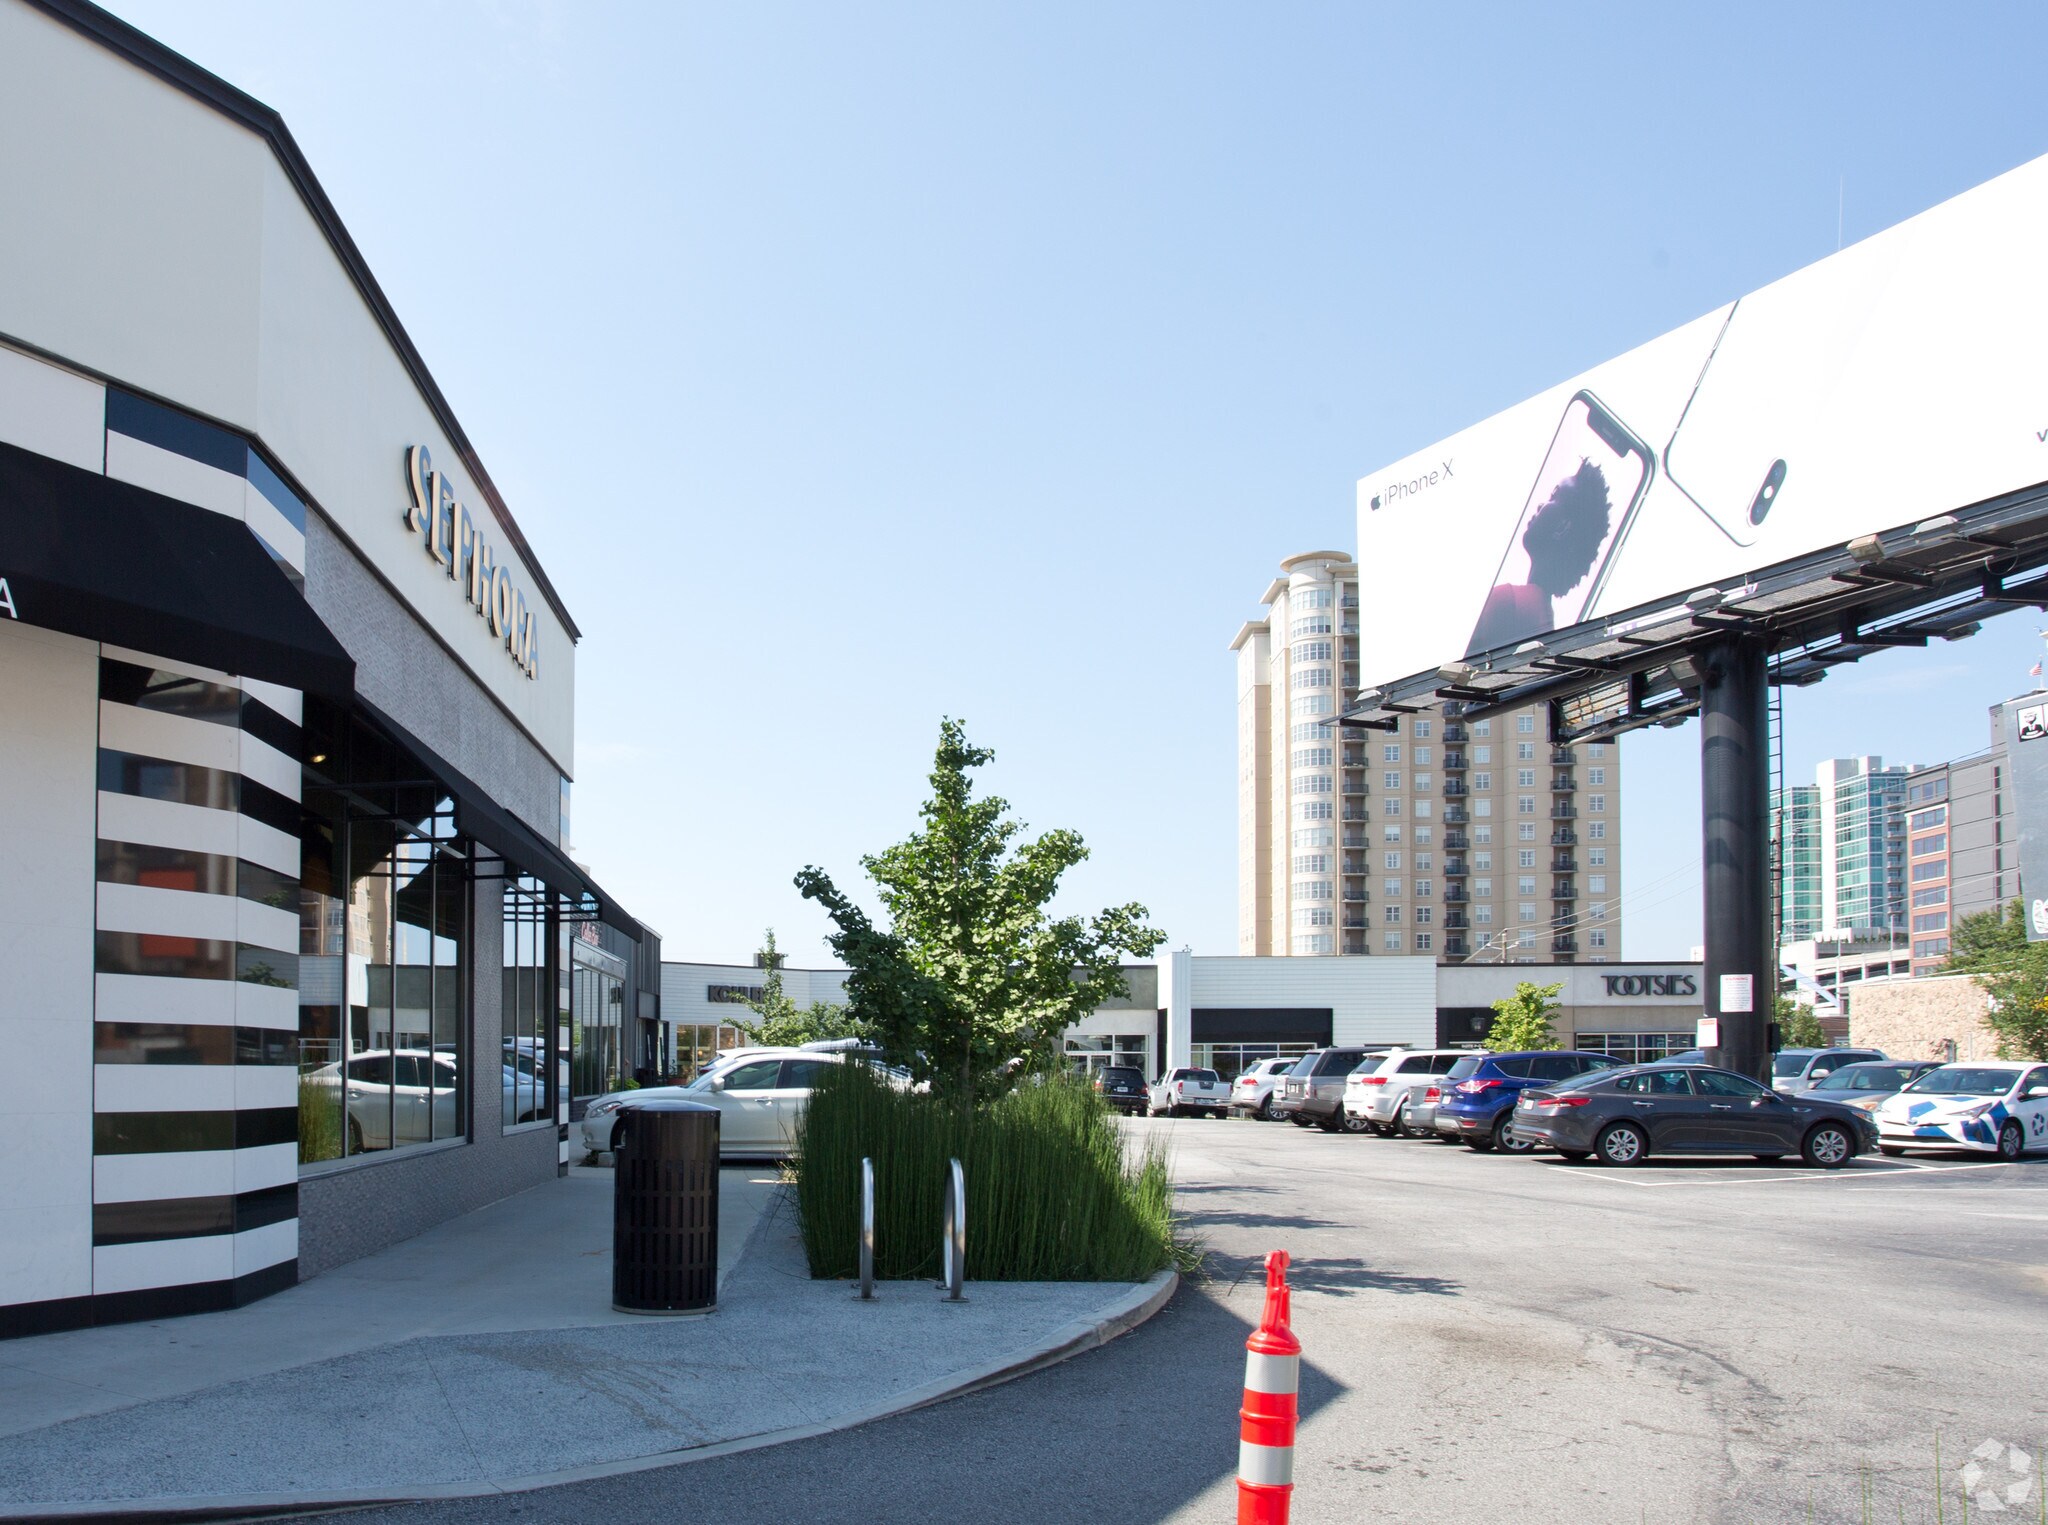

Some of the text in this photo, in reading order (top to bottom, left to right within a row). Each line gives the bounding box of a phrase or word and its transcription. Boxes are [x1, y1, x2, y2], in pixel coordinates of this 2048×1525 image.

[1384, 458, 1454, 506] iPhone X
[404, 445, 539, 681] SEPHORA
[1601, 974, 1697, 996] TOOTSIES
